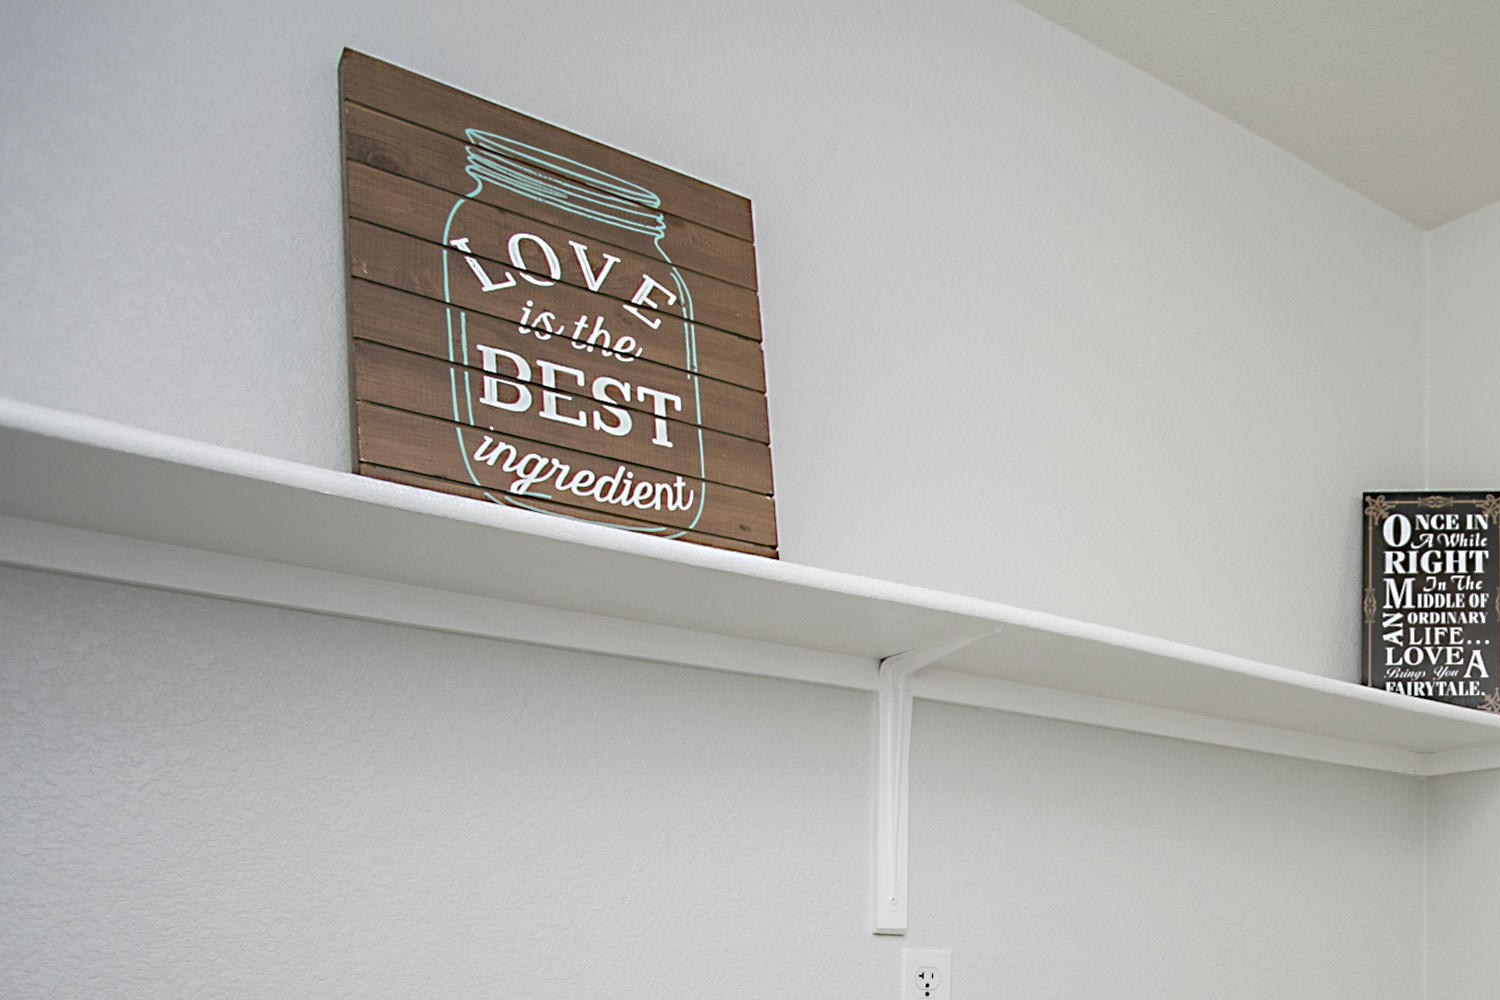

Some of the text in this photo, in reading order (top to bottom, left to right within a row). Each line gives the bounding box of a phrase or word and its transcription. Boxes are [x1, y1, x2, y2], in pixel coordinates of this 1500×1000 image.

[450, 233, 677, 330] LOVE
[518, 301, 643, 362] is the
[476, 344, 681, 447] BEST
[474, 427, 694, 511] ingredient
[1382, 513, 1488, 548] ONCE IN
[1411, 533, 1488, 549] A While
[1383, 550, 1489, 574] RIGHT
[1383, 578, 1490, 610] MIDDLE OF
[1423, 575, 1483, 592] In The
[1382, 612, 1404, 646] AN
[1407, 612, 1487, 624] ORDINARY
[1385, 646, 1464, 666] LOVE
[1463, 649, 1489, 678] A
[1384, 665, 1459, 681] Brings You
